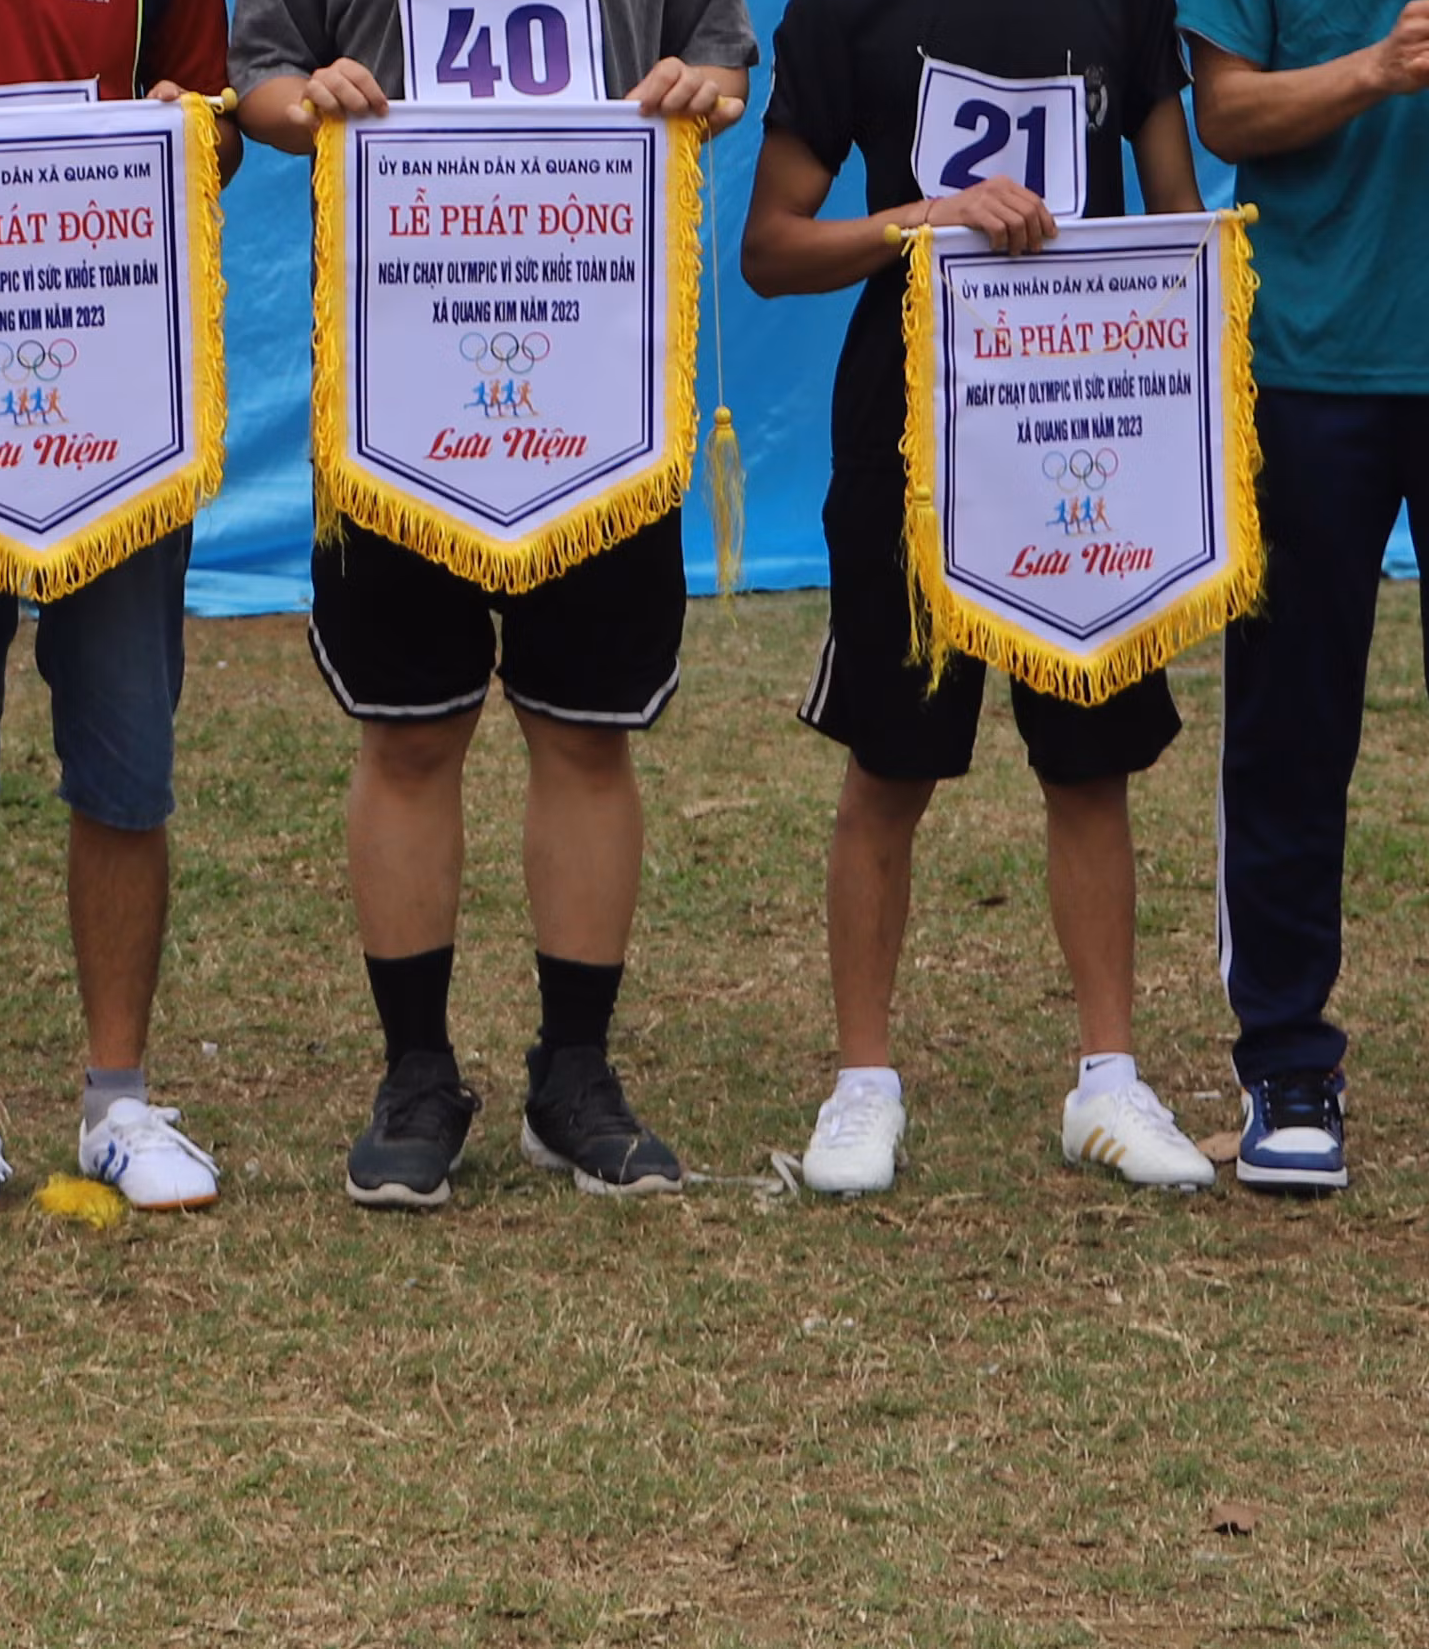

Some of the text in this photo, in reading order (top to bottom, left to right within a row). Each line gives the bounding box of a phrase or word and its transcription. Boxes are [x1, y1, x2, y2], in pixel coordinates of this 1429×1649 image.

[436, 4, 571, 98] 40
[402, 161, 432, 176] BAN
[545, 159, 600, 175] QUANG
[606, 159, 632, 174] KIM
[939, 98, 1046, 199] 21
[58, 200, 155, 251] ĐỘNG
[389, 187, 634, 243] LỄ PHÁT ĐỘNG
[447, 260, 498, 284] OLYMPIC
[451, 300, 491, 325] QUANG
[494, 300, 517, 323] KIM
[551, 300, 580, 322] 2023
[973, 310, 1190, 362] LỄ PHÁT ĐỘNG
